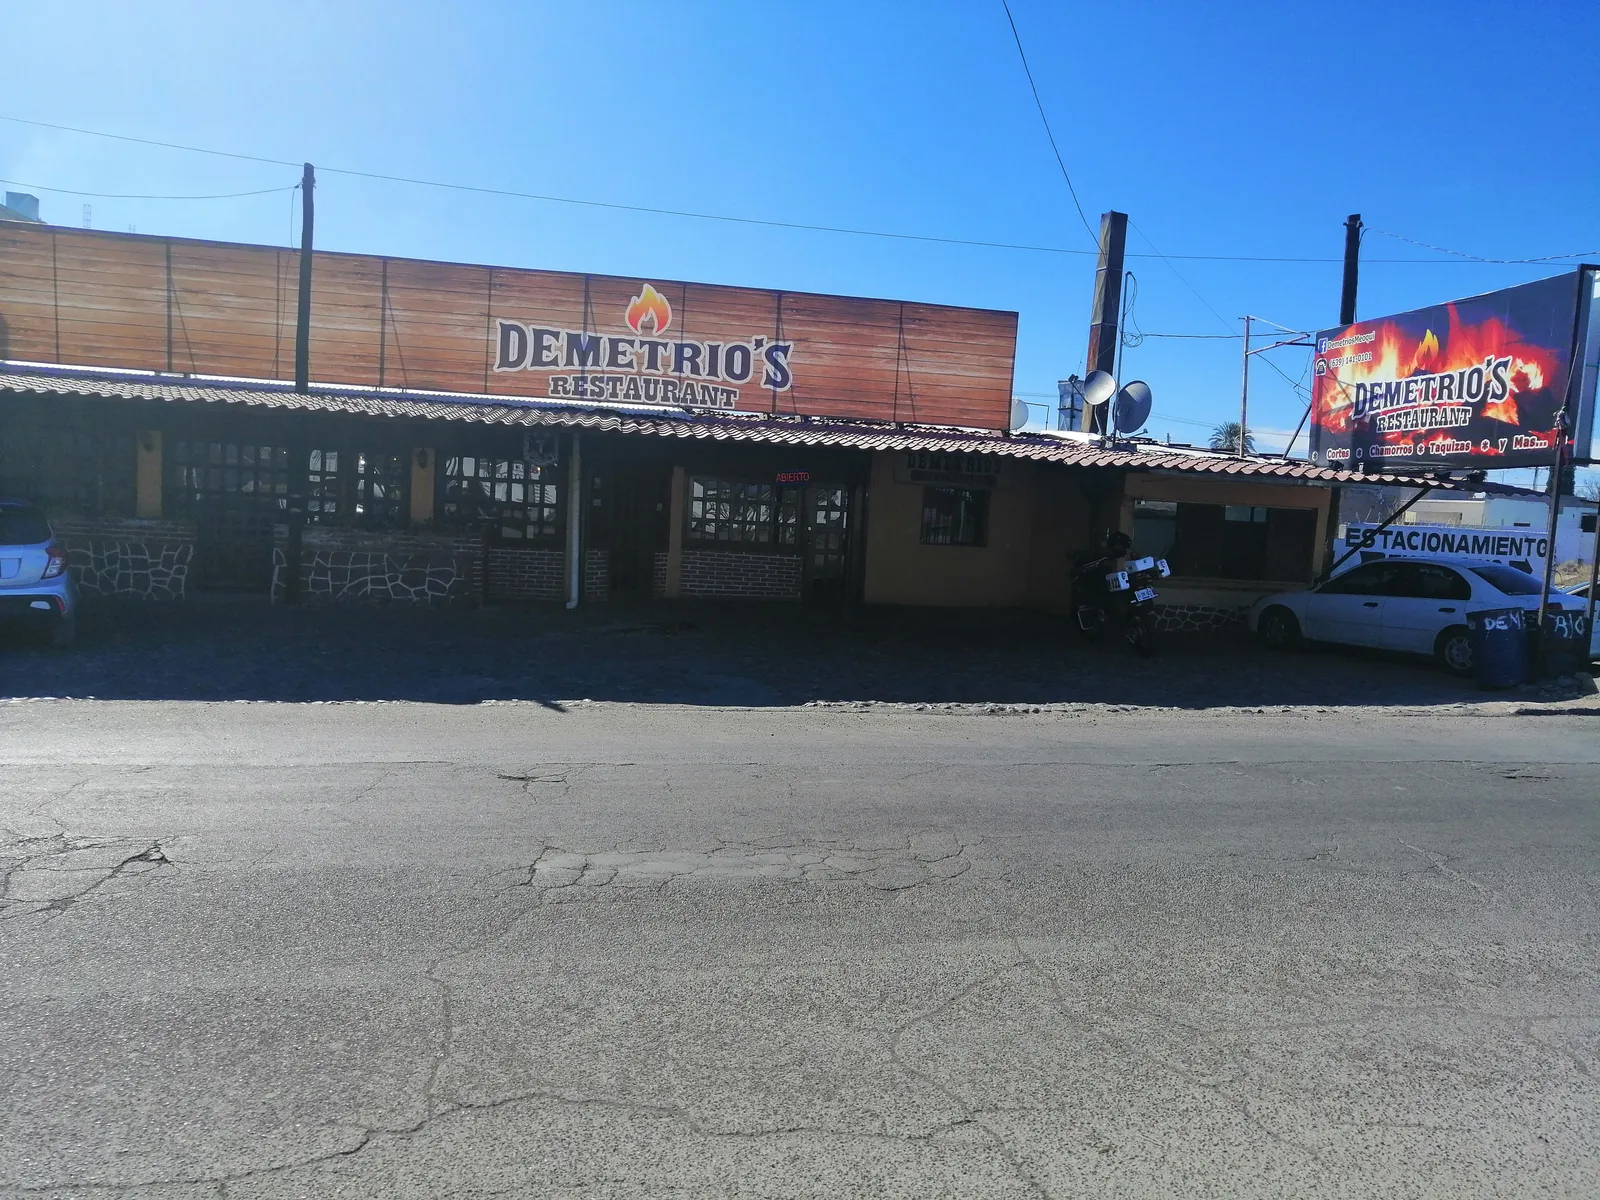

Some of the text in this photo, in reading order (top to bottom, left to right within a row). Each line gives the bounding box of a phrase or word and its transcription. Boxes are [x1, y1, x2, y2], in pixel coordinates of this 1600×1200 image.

[1327, 330, 1376, 350] DemetriosMeoqui
[493, 319, 794, 391] DEMETRIO'S
[1329, 351, 1373, 370] (639) 141-0101
[549, 375, 740, 409] RESTAURANT
[1351, 354, 1513, 420] DEMETRIO'S
[1376, 406, 1472, 433] RESTAURANT
[1326, 448, 1350, 460] Cortes
[1369, 444, 1413, 457] Chamorros
[1429, 440, 1472, 456] Taquizas
[1512, 435, 1549, 449] Mas...
[776, 471, 810, 482] ABIERTO
[1345, 527, 1549, 557] ESTACIONAMIENTO
